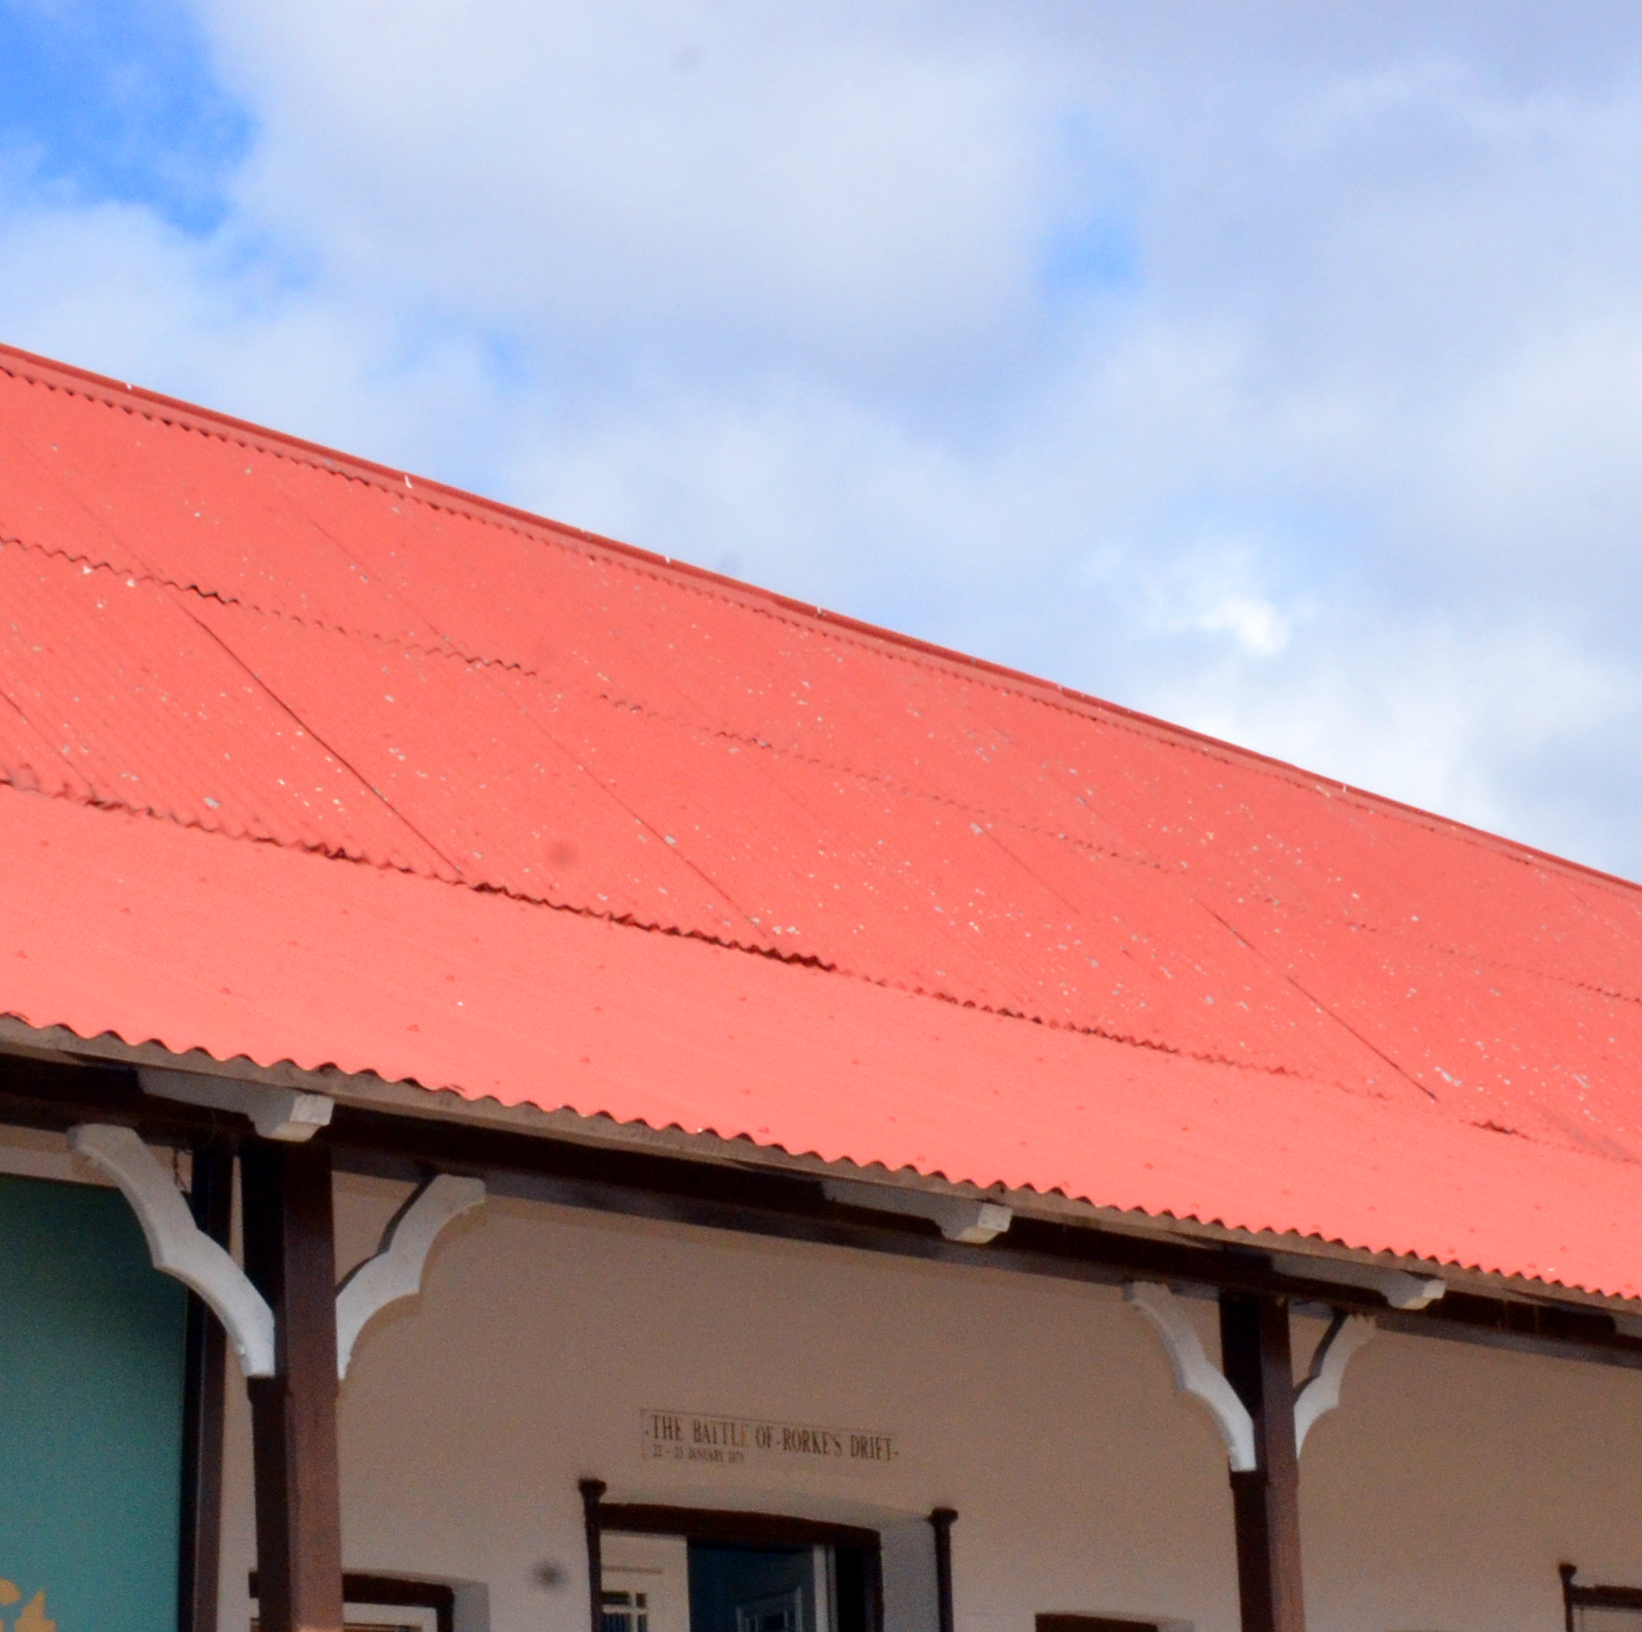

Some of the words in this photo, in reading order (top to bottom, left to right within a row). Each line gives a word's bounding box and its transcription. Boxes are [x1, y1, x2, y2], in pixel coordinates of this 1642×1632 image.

[651, 1414, 683, 1441] THE
[693, 1418, 748, 1448] BATTLE
[755, 1424, 773, 1449] OF
[850, 1434, 893, 1461] DRIFT
